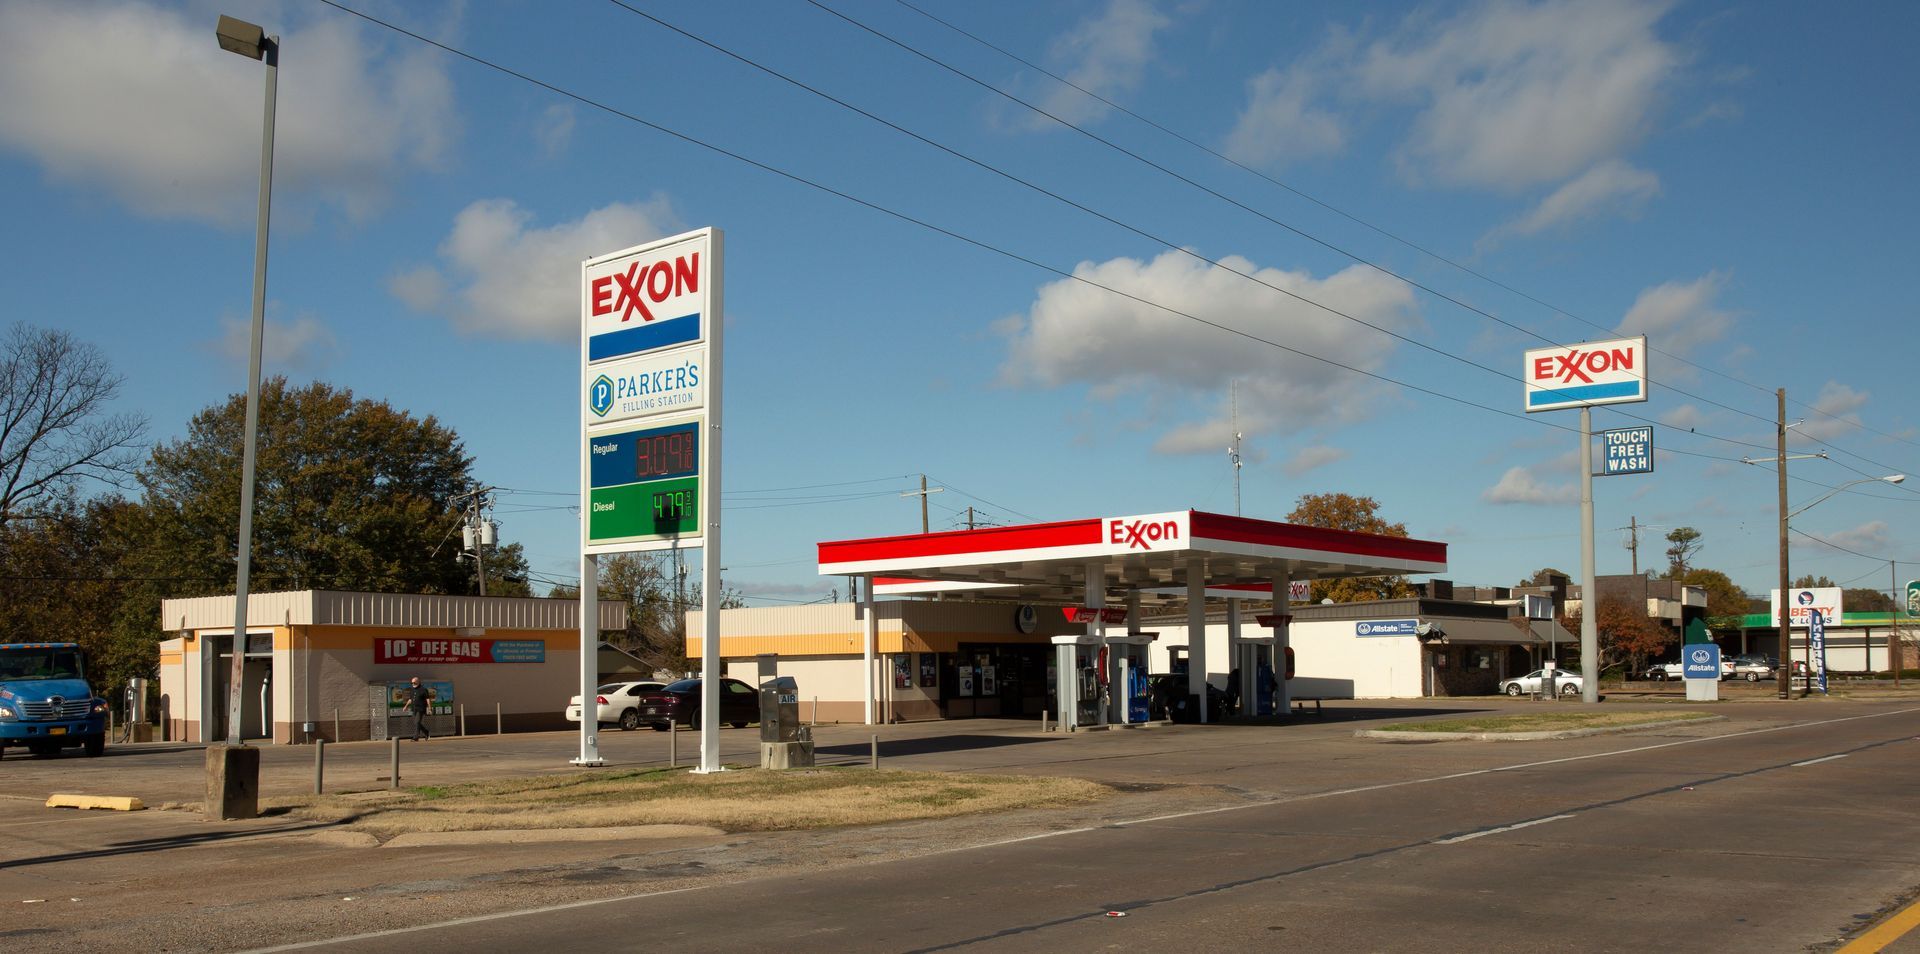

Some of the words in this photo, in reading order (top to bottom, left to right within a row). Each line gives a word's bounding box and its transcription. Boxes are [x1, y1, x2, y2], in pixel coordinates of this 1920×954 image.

[591, 252, 700, 322] EXXON
[1534, 347, 1633, 384] EXXON
[617, 360, 699, 399] PARKER'S
[623, 398, 655, 413] FILLING
[658, 392, 693, 407] STATION
[1607, 431, 1648, 445] TOUCH
[593, 442, 618, 455] Regular
[1610, 444, 1644, 458] FREE
[1608, 457, 1647, 471] WASH
[593, 500, 615, 512] Diesel
[1110, 519, 1179, 550] Exxon
[1289, 582, 1308, 599] xxon
[1778, 607, 1835, 617] BETY
[1778, 617, 1795, 625] TX
[1371, 624, 1398, 633] Allstate
[421, 641, 448, 655] OFF
[451, 641, 480, 658] GAS
[1687, 664, 1716, 672] Allstate
[782, 695, 796, 703] AIR
